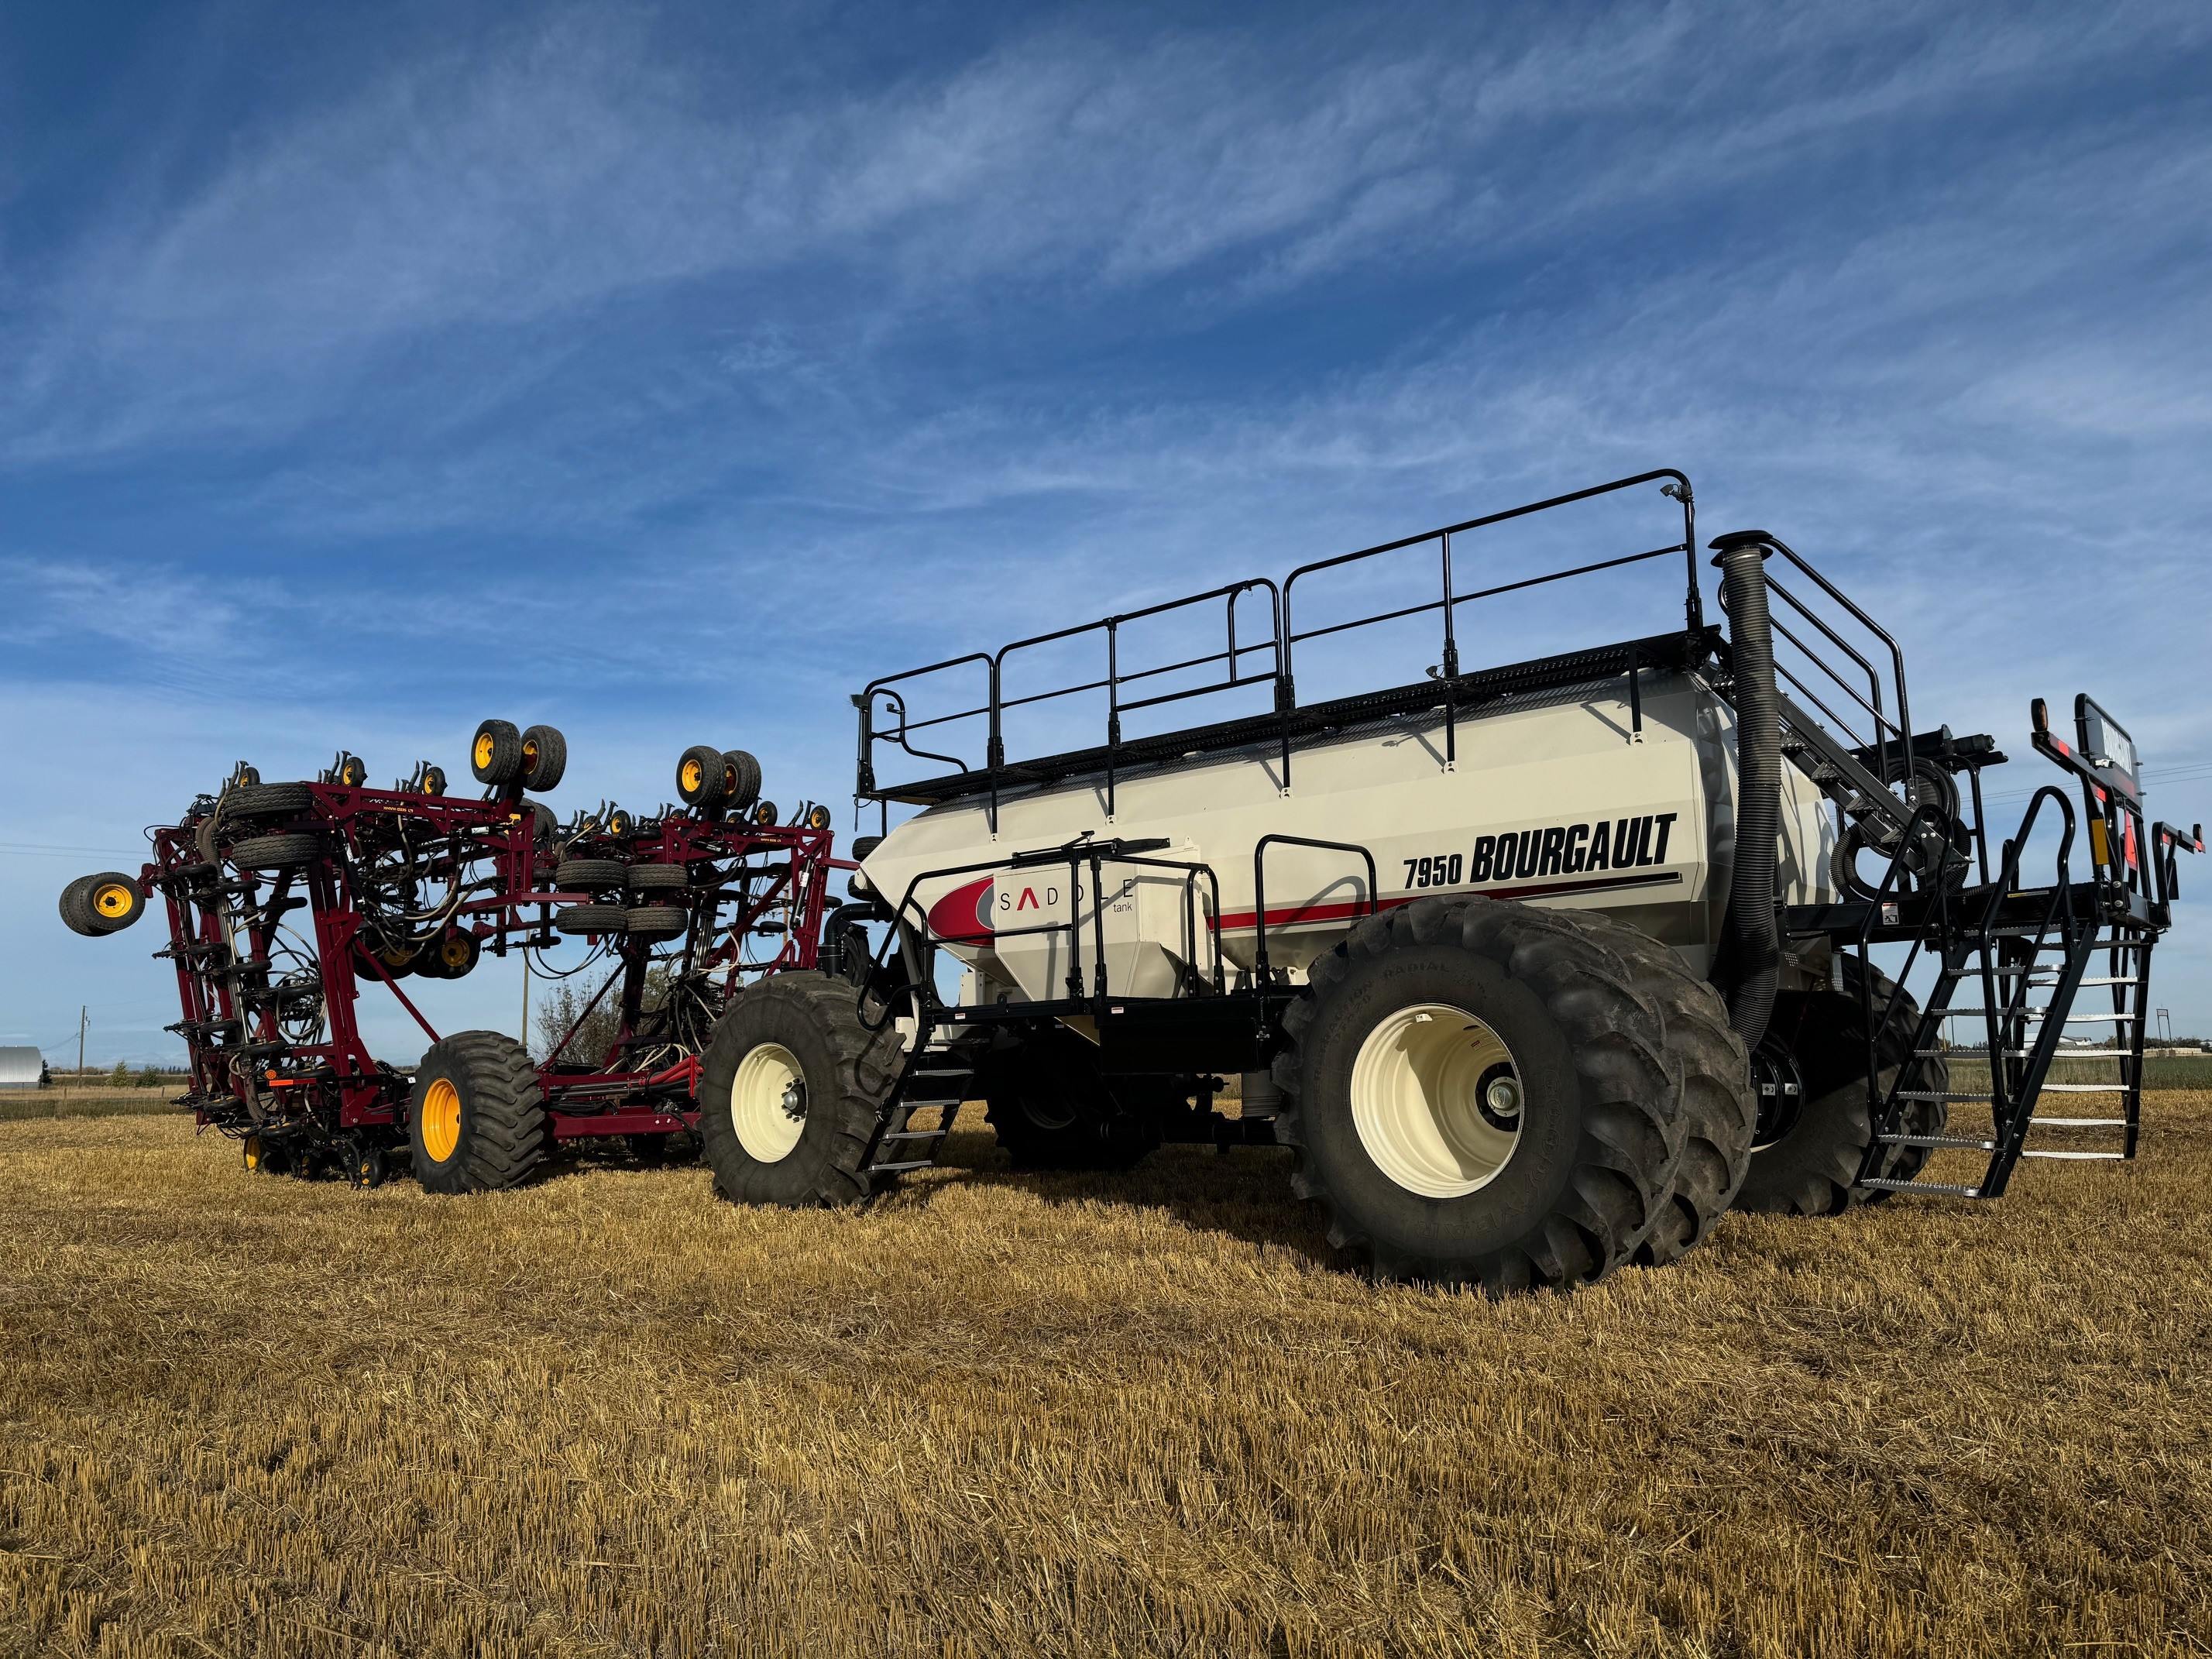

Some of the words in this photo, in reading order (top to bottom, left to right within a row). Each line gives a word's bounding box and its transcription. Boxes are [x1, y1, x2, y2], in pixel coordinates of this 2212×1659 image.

[1403, 854, 1462, 889] 7950
[1469, 812, 1677, 884] BOURGAULT
[1113, 902, 1133, 912] tank
[1381, 960, 1451, 981] RADIAL
[1417, 1068, 1562, 1242] GOODYEAR
